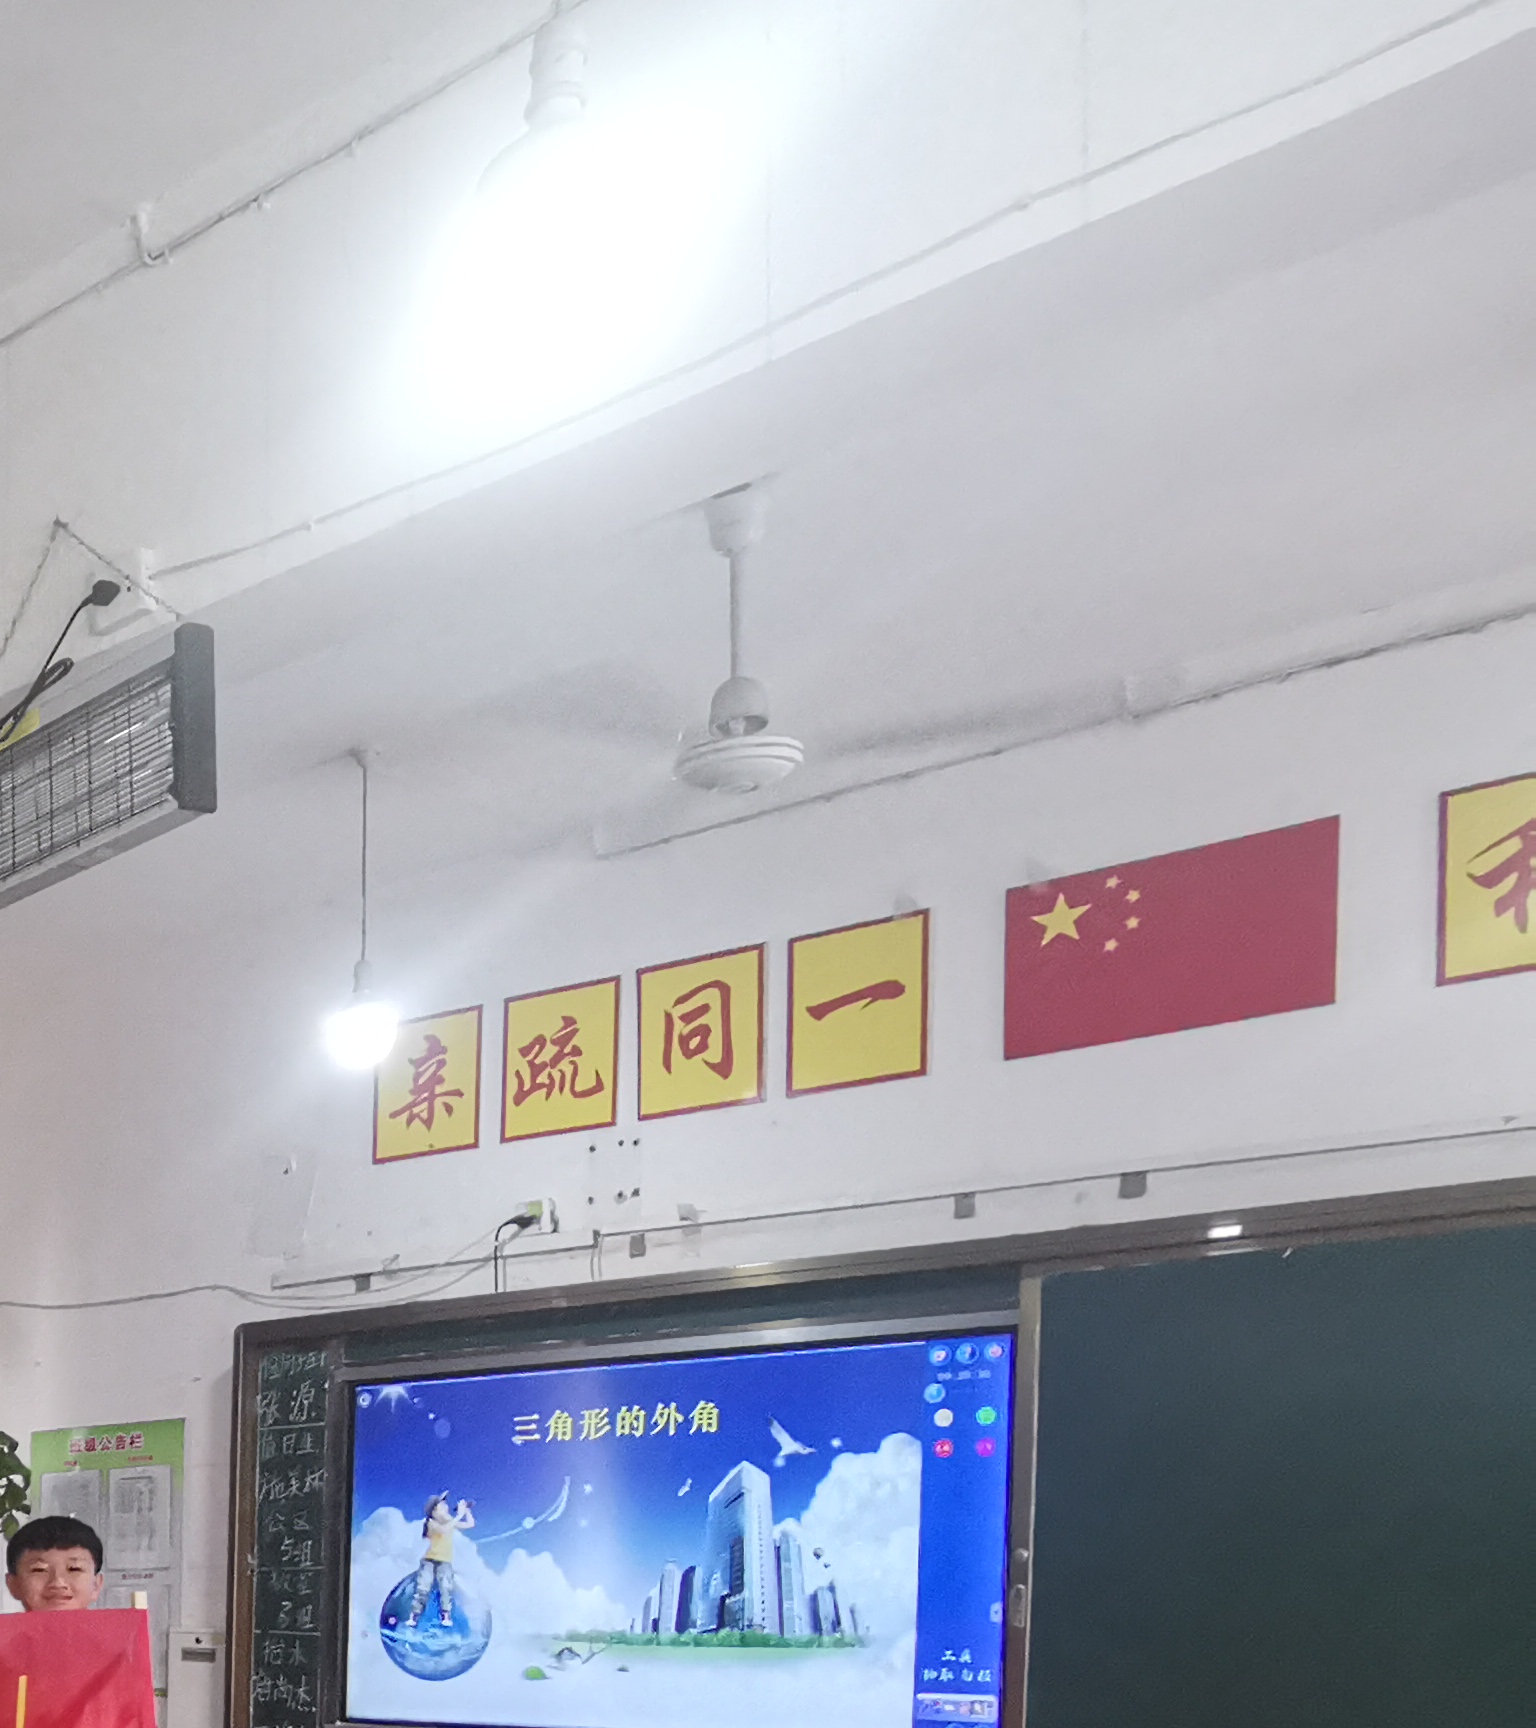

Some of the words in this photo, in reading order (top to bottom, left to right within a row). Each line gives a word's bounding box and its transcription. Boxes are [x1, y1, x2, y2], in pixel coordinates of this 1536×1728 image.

[511, 1400, 722, 1444] 三角形的外角
